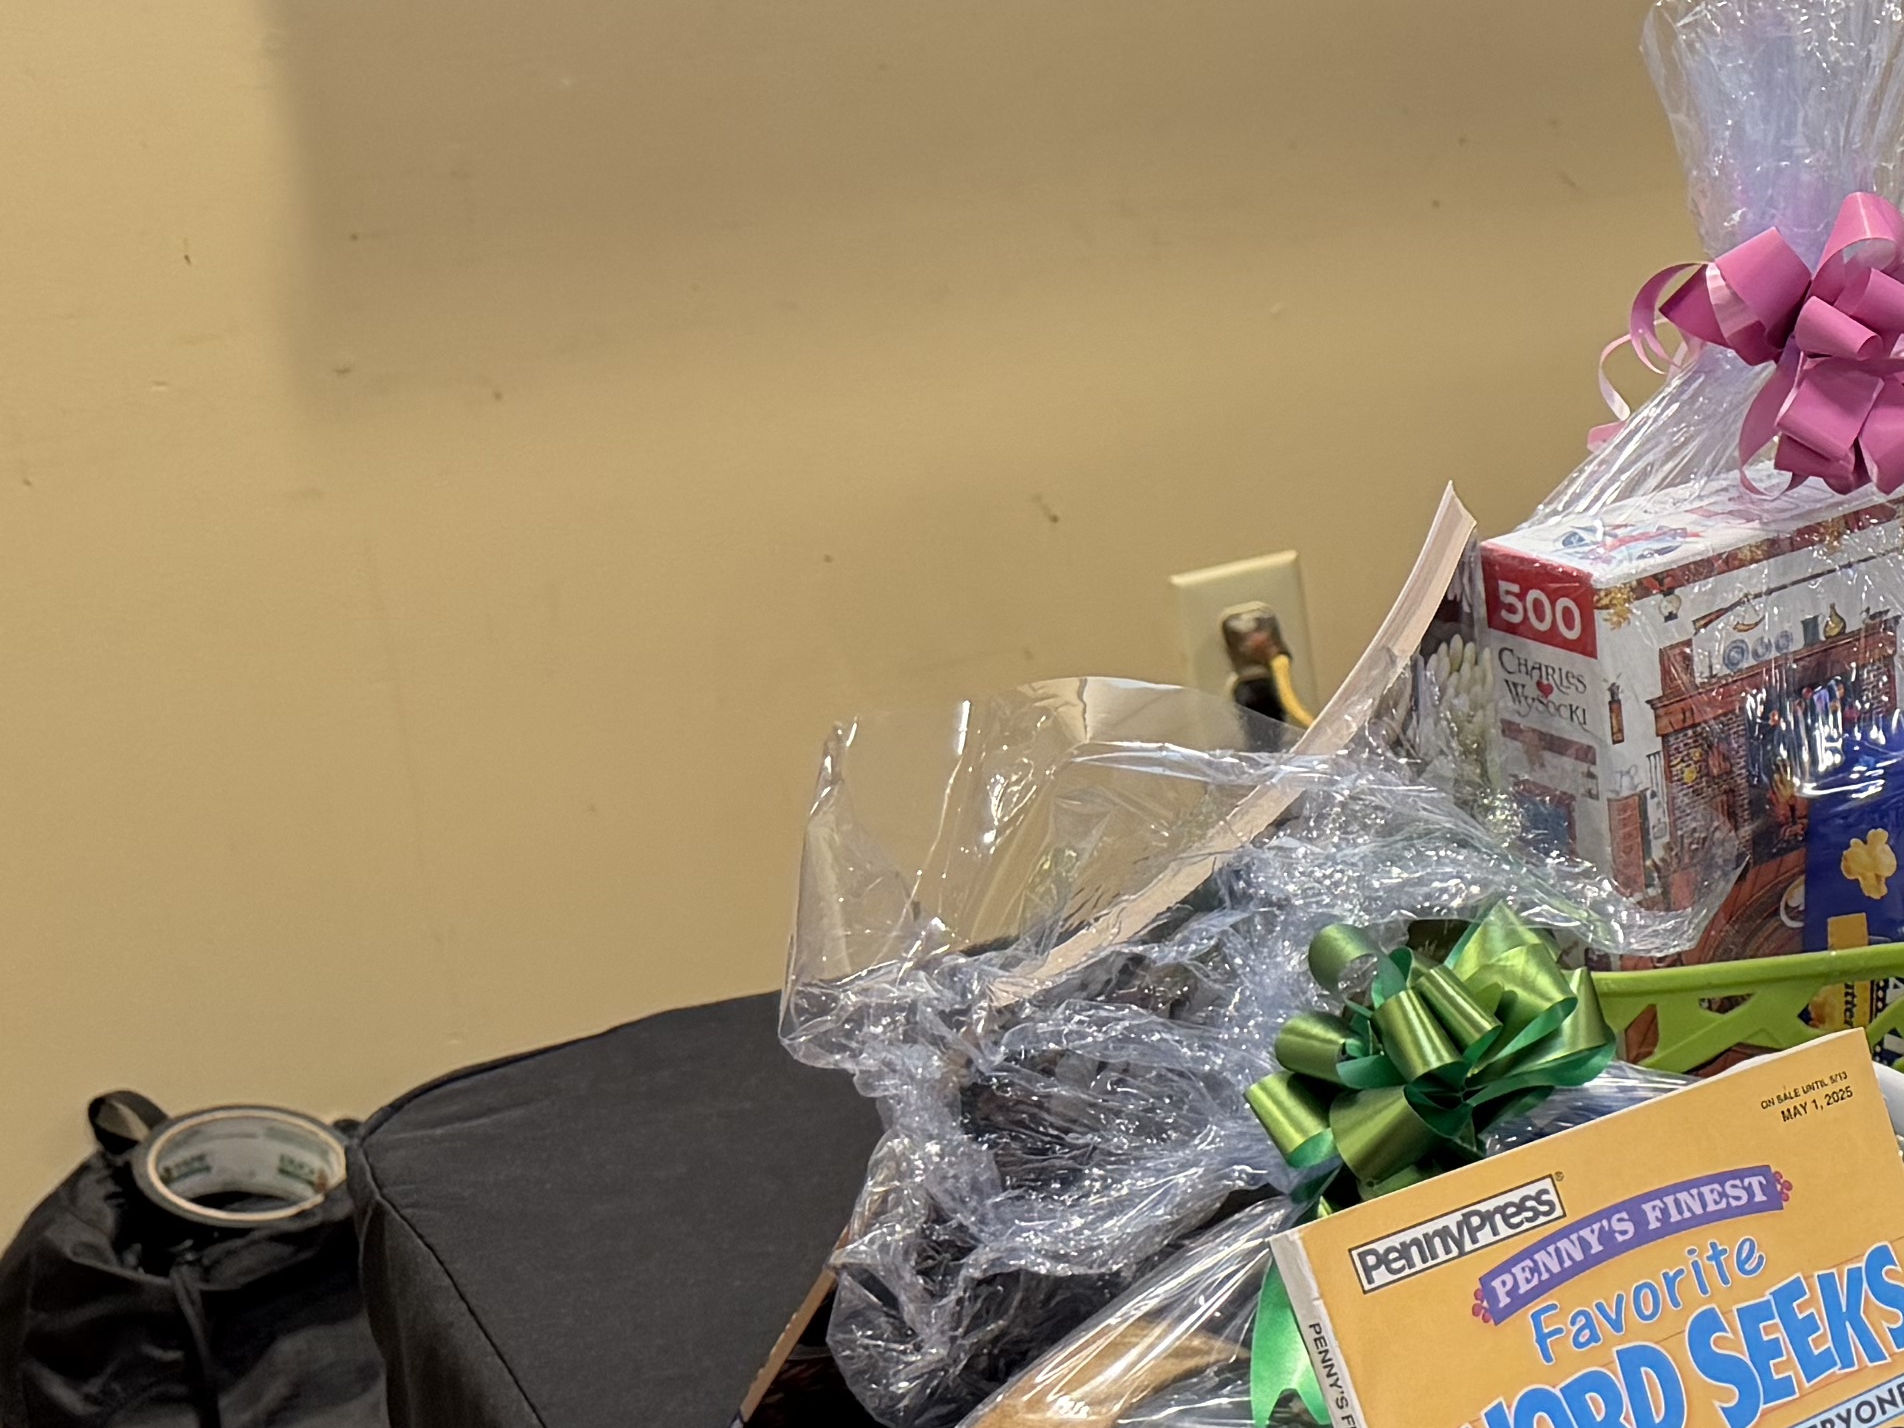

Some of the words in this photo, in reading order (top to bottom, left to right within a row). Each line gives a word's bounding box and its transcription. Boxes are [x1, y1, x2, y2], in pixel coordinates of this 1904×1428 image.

[1498, 580, 1582, 640] 500
[1760, 1098, 1775, 1111] ON
[1776, 1088, 1801, 1106] SALE
[1802, 1078, 1829, 1097] UNTIL
[1780, 1103, 1808, 1123] MAY
[1811, 1098, 1824, 1114] 1,
[1825, 1086, 1854, 1109] 2025
[1358, 1185, 1559, 1286] PennyPress
[1490, 1213, 1636, 1308] PENNY'S
[1643, 1173, 1768, 1230] FINEST
[1530, 1234, 1767, 1365] Favorite
[1308, 1322, 1349, 1413] PENNY'S
